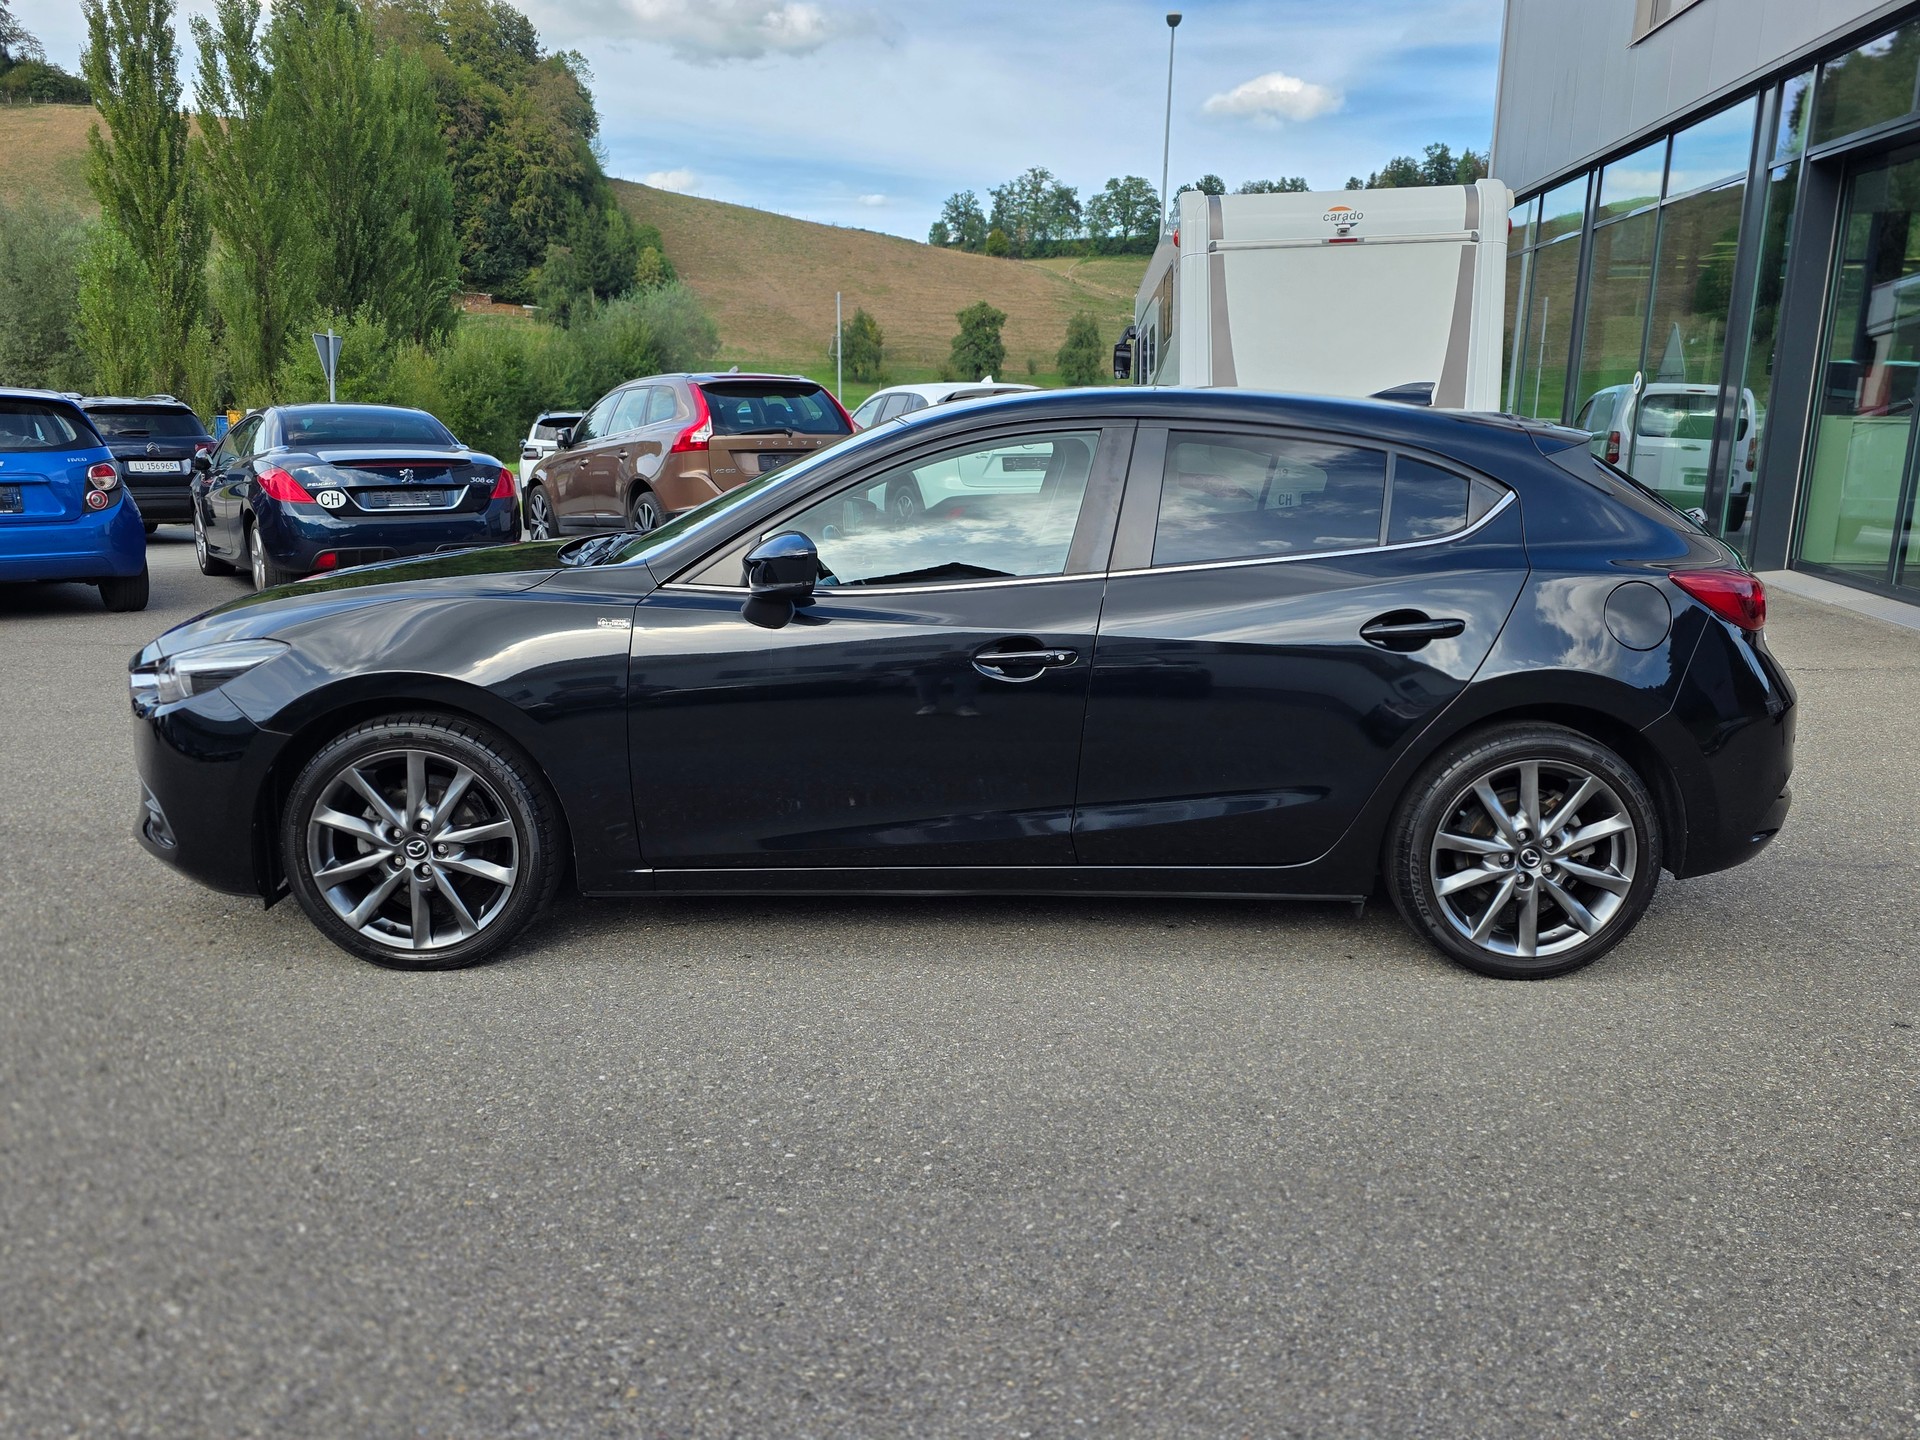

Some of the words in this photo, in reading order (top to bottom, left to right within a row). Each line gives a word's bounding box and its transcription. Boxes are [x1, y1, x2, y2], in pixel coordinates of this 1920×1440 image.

[1322, 211, 1364, 221] carado
[320, 492, 340, 506] CH
[1278, 493, 1292, 506] CH
[1411, 853, 1431, 917] DUNLOP
